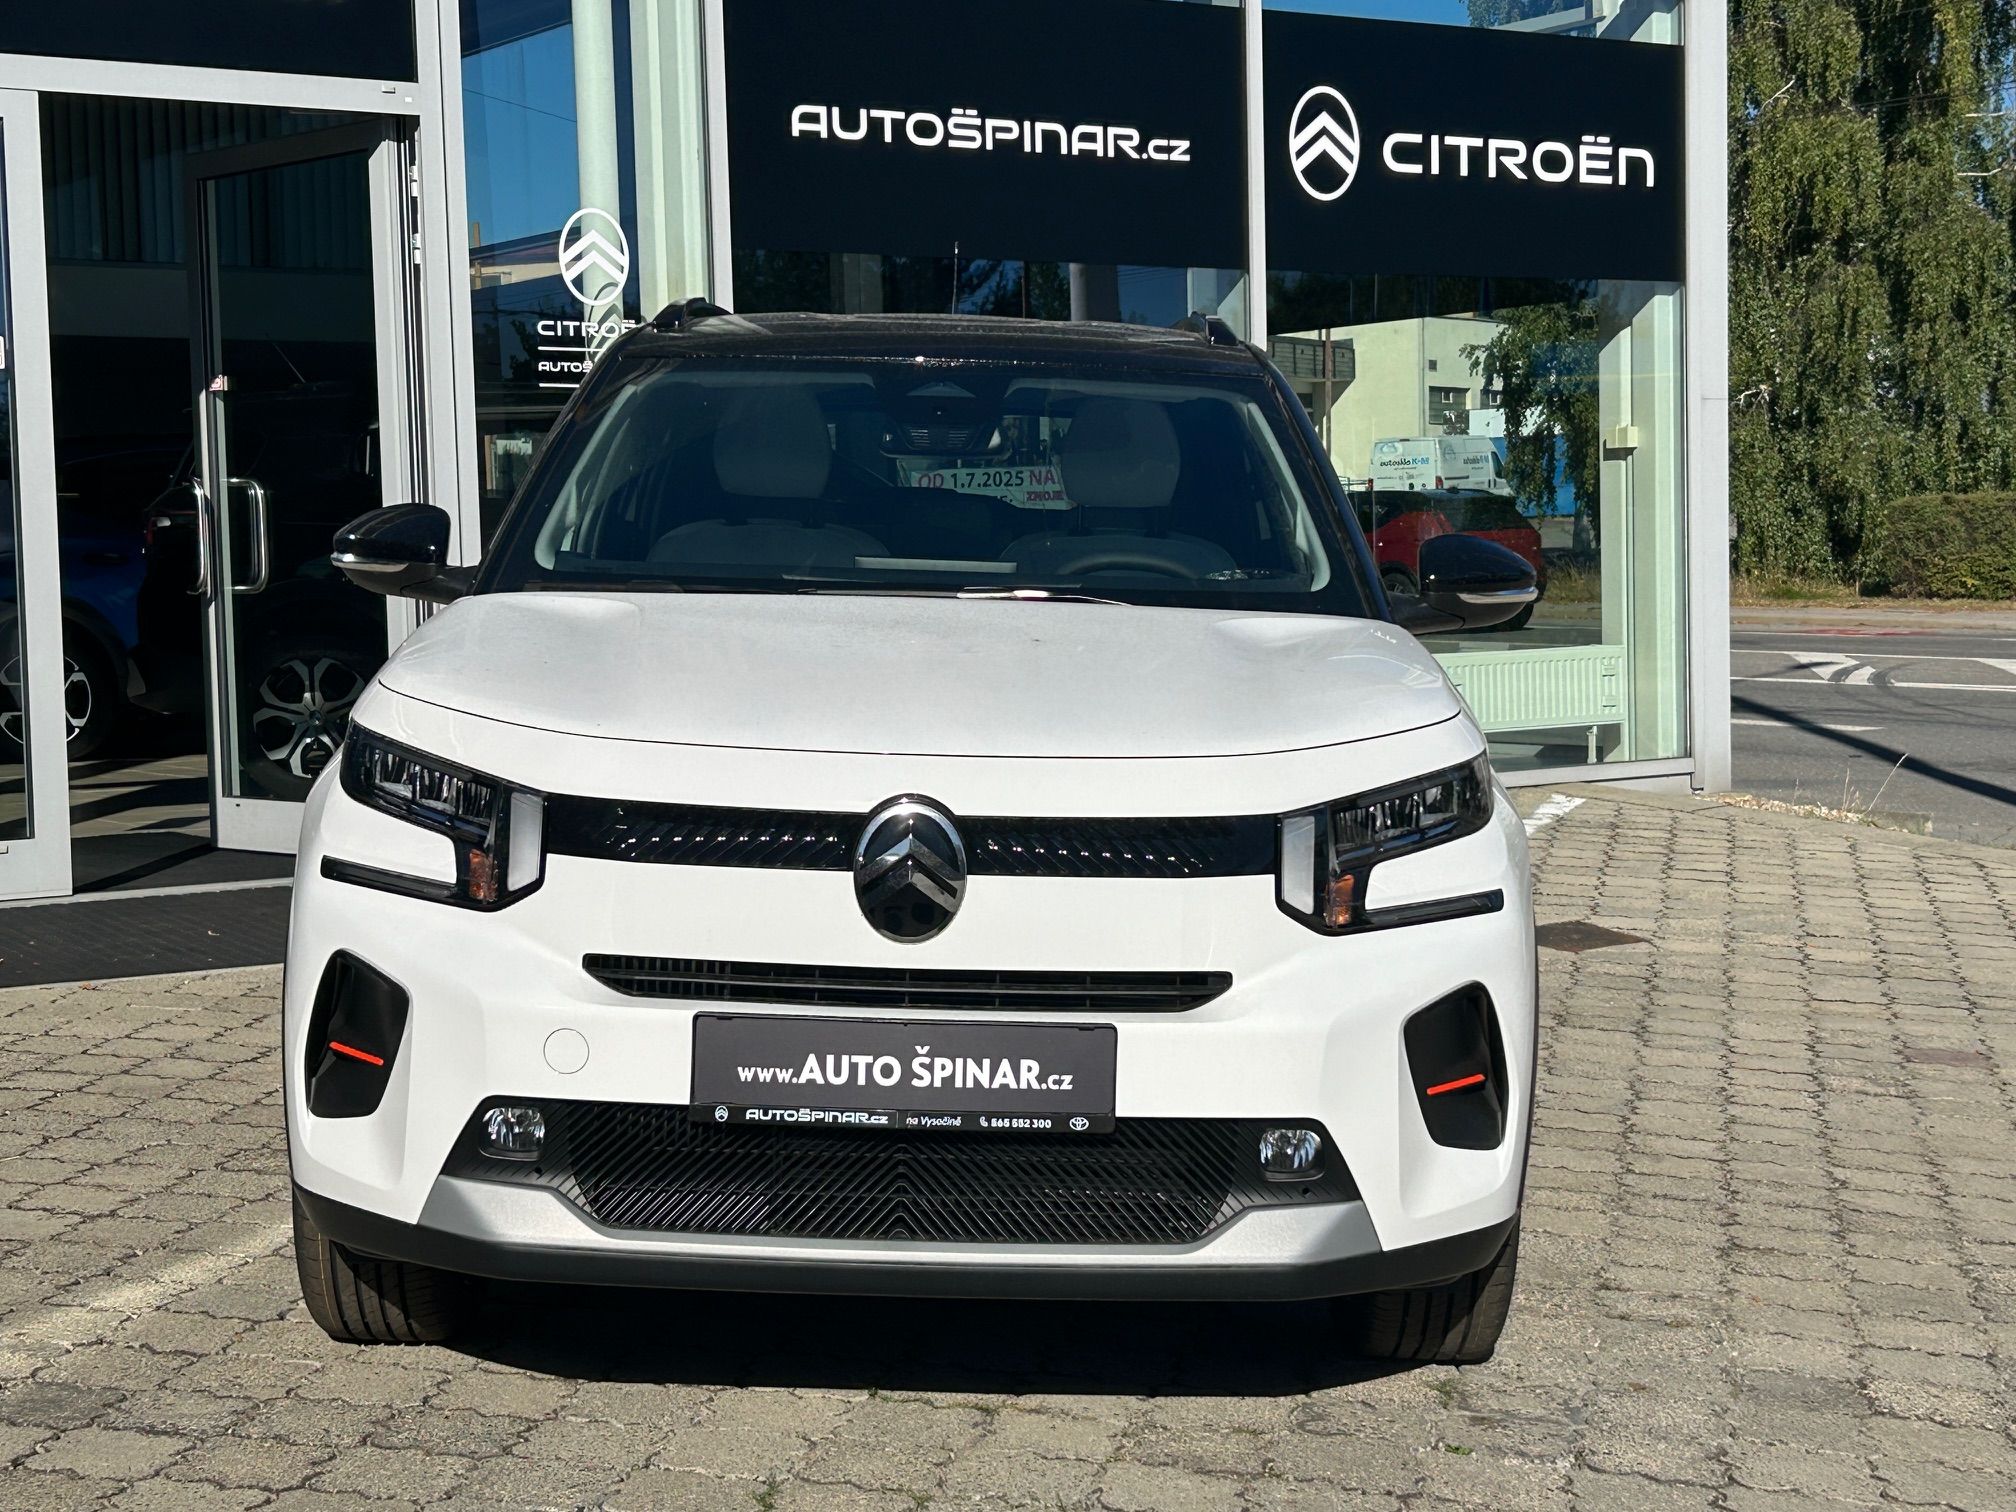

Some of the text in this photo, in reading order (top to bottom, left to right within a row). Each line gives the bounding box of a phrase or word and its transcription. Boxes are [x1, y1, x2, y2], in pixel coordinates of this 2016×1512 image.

[1382, 132, 1655, 188] CITROËN
[537, 319, 638, 338] CITROË
[538, 360, 594, 373] AUTOŠ
[950, 471, 1024, 489] 1.7.2025
[1029, 469, 1057, 486] NA
[737, 1045, 1074, 1090] www.AUTO ŠPINAR.cz
[906, 1117, 919, 1125] na
[1032, 1118, 1052, 1129] 300
